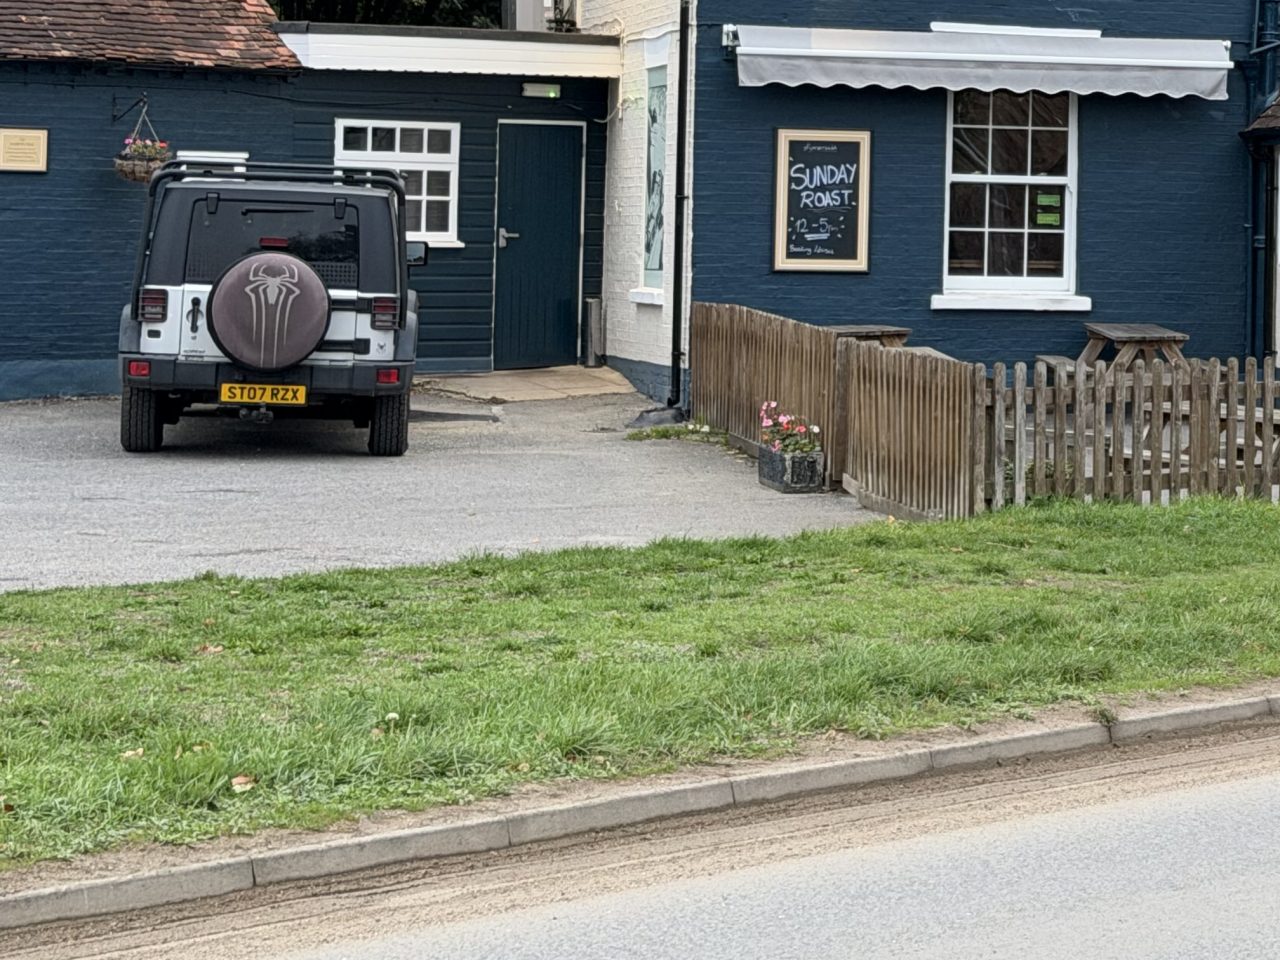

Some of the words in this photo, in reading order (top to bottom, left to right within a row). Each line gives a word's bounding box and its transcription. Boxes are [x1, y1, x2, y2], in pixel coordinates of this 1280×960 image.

[790, 163, 857, 190] SUNDAY
[800, 190, 853, 208] ROAST
[227, 386, 266, 401] ST07
[270, 387, 300, 402] RZX
